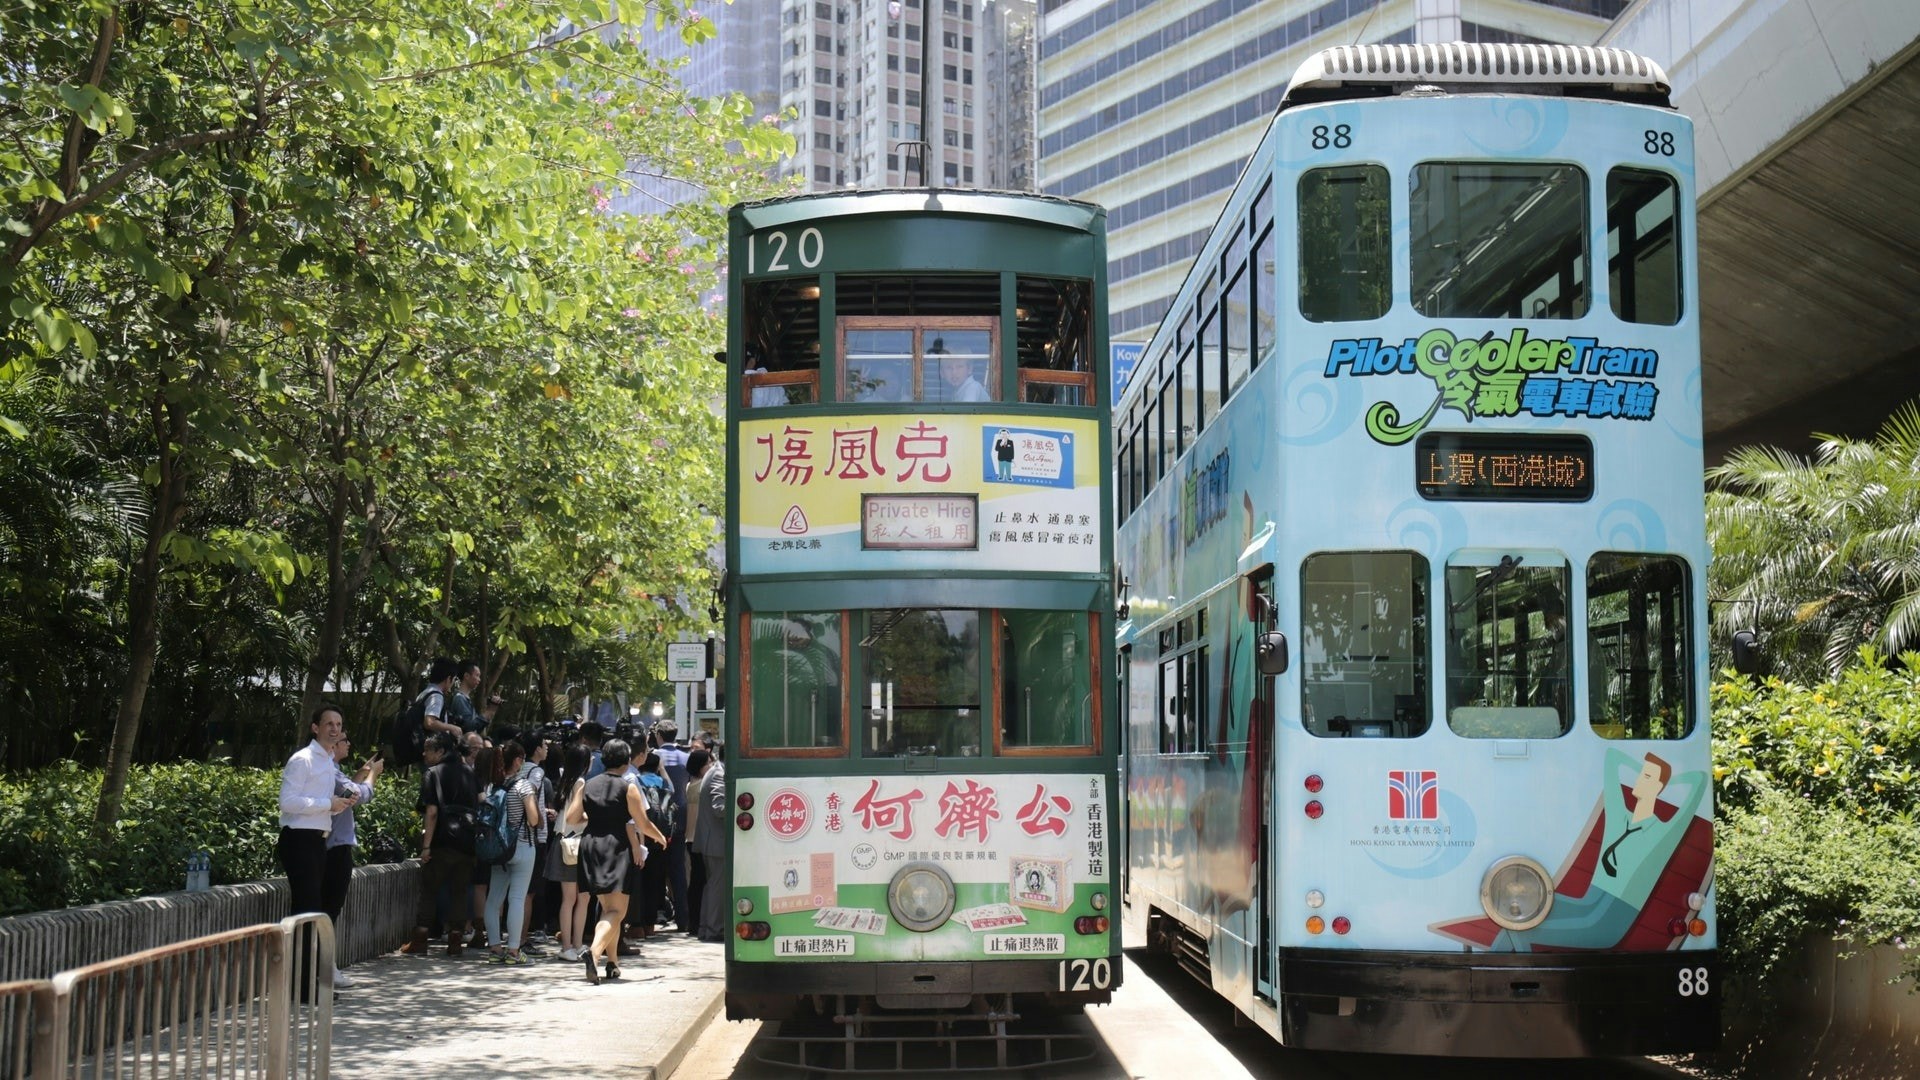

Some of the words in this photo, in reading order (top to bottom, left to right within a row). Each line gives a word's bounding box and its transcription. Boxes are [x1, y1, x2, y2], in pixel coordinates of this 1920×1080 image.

[1311, 124, 1352, 151] 88
[1643, 129, 1676, 157] 88
[747, 227, 824, 274] 120
[754, 420, 952, 486] 傷風克
[1420, 453, 1585, 487] 上環(西港城)
[869, 502, 929, 518] Private
[937, 502, 971, 518] Hire
[994, 511, 1040, 524] 止鼻水
[1047, 513, 1091, 526] 通鼻塞
[871, 523, 969, 541] 私人租用
[1089, 778, 1099, 799] 全部
[825, 792, 841, 831] 香港
[852, 778, 1073, 844] 何濟公
[1087, 803, 1103, 876] 香港製造
[1372, 825, 1452, 835] 香港電車有限公司
[1350, 839, 1372, 847] HONG
[1373, 839, 1396, 847] KONG
[1398, 839, 1442, 848] TRAMWAYS,
[1443, 839, 1475, 848] LIMITED
[883, 851, 905, 861] GMP
[781, 938, 849, 954] 止痛退熱片
[990, 937, 1059, 952] 止痛退熱散
[1058, 958, 1111, 992] 120
[1677, 967, 1709, 997] 88
